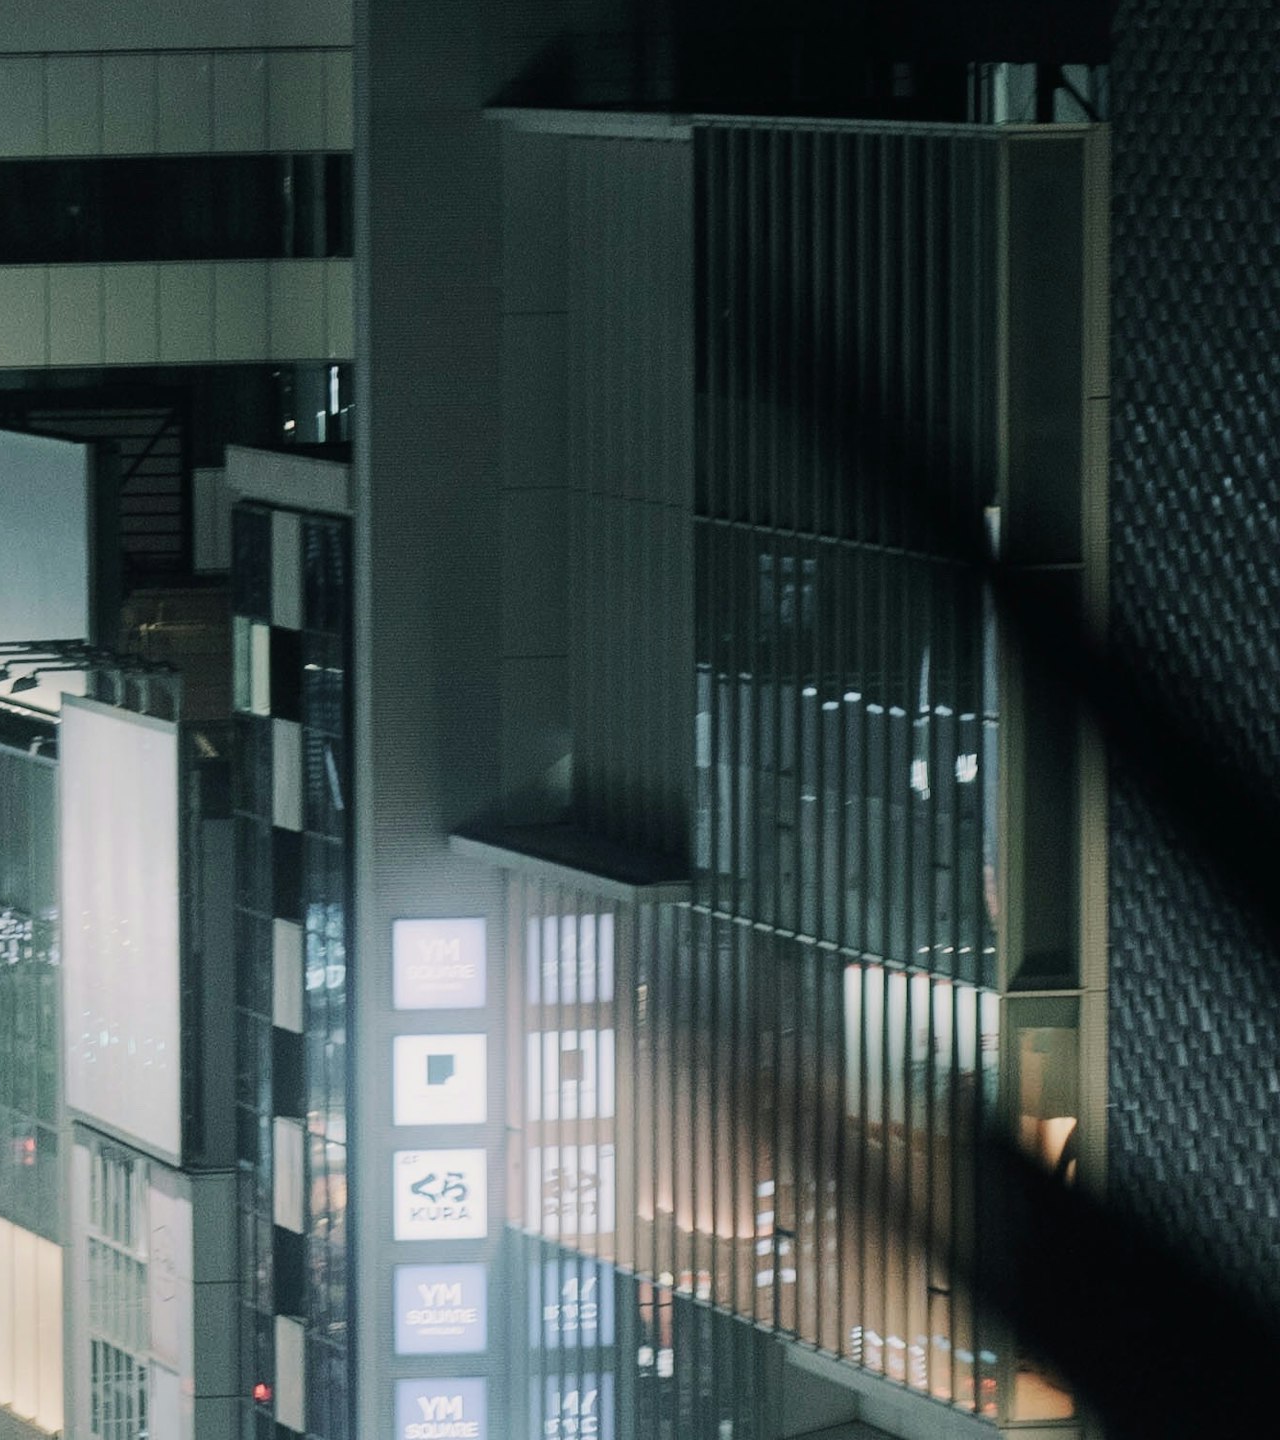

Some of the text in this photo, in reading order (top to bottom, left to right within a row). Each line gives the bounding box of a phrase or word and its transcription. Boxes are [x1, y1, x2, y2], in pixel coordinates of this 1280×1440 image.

[410, 1171, 469, 1203] くら
[410, 1206, 471, 1222] KURA
[418, 1283, 462, 1307] YM
[416, 1395, 463, 1422] YM
[404, 1421, 479, 1440] SQUARE
